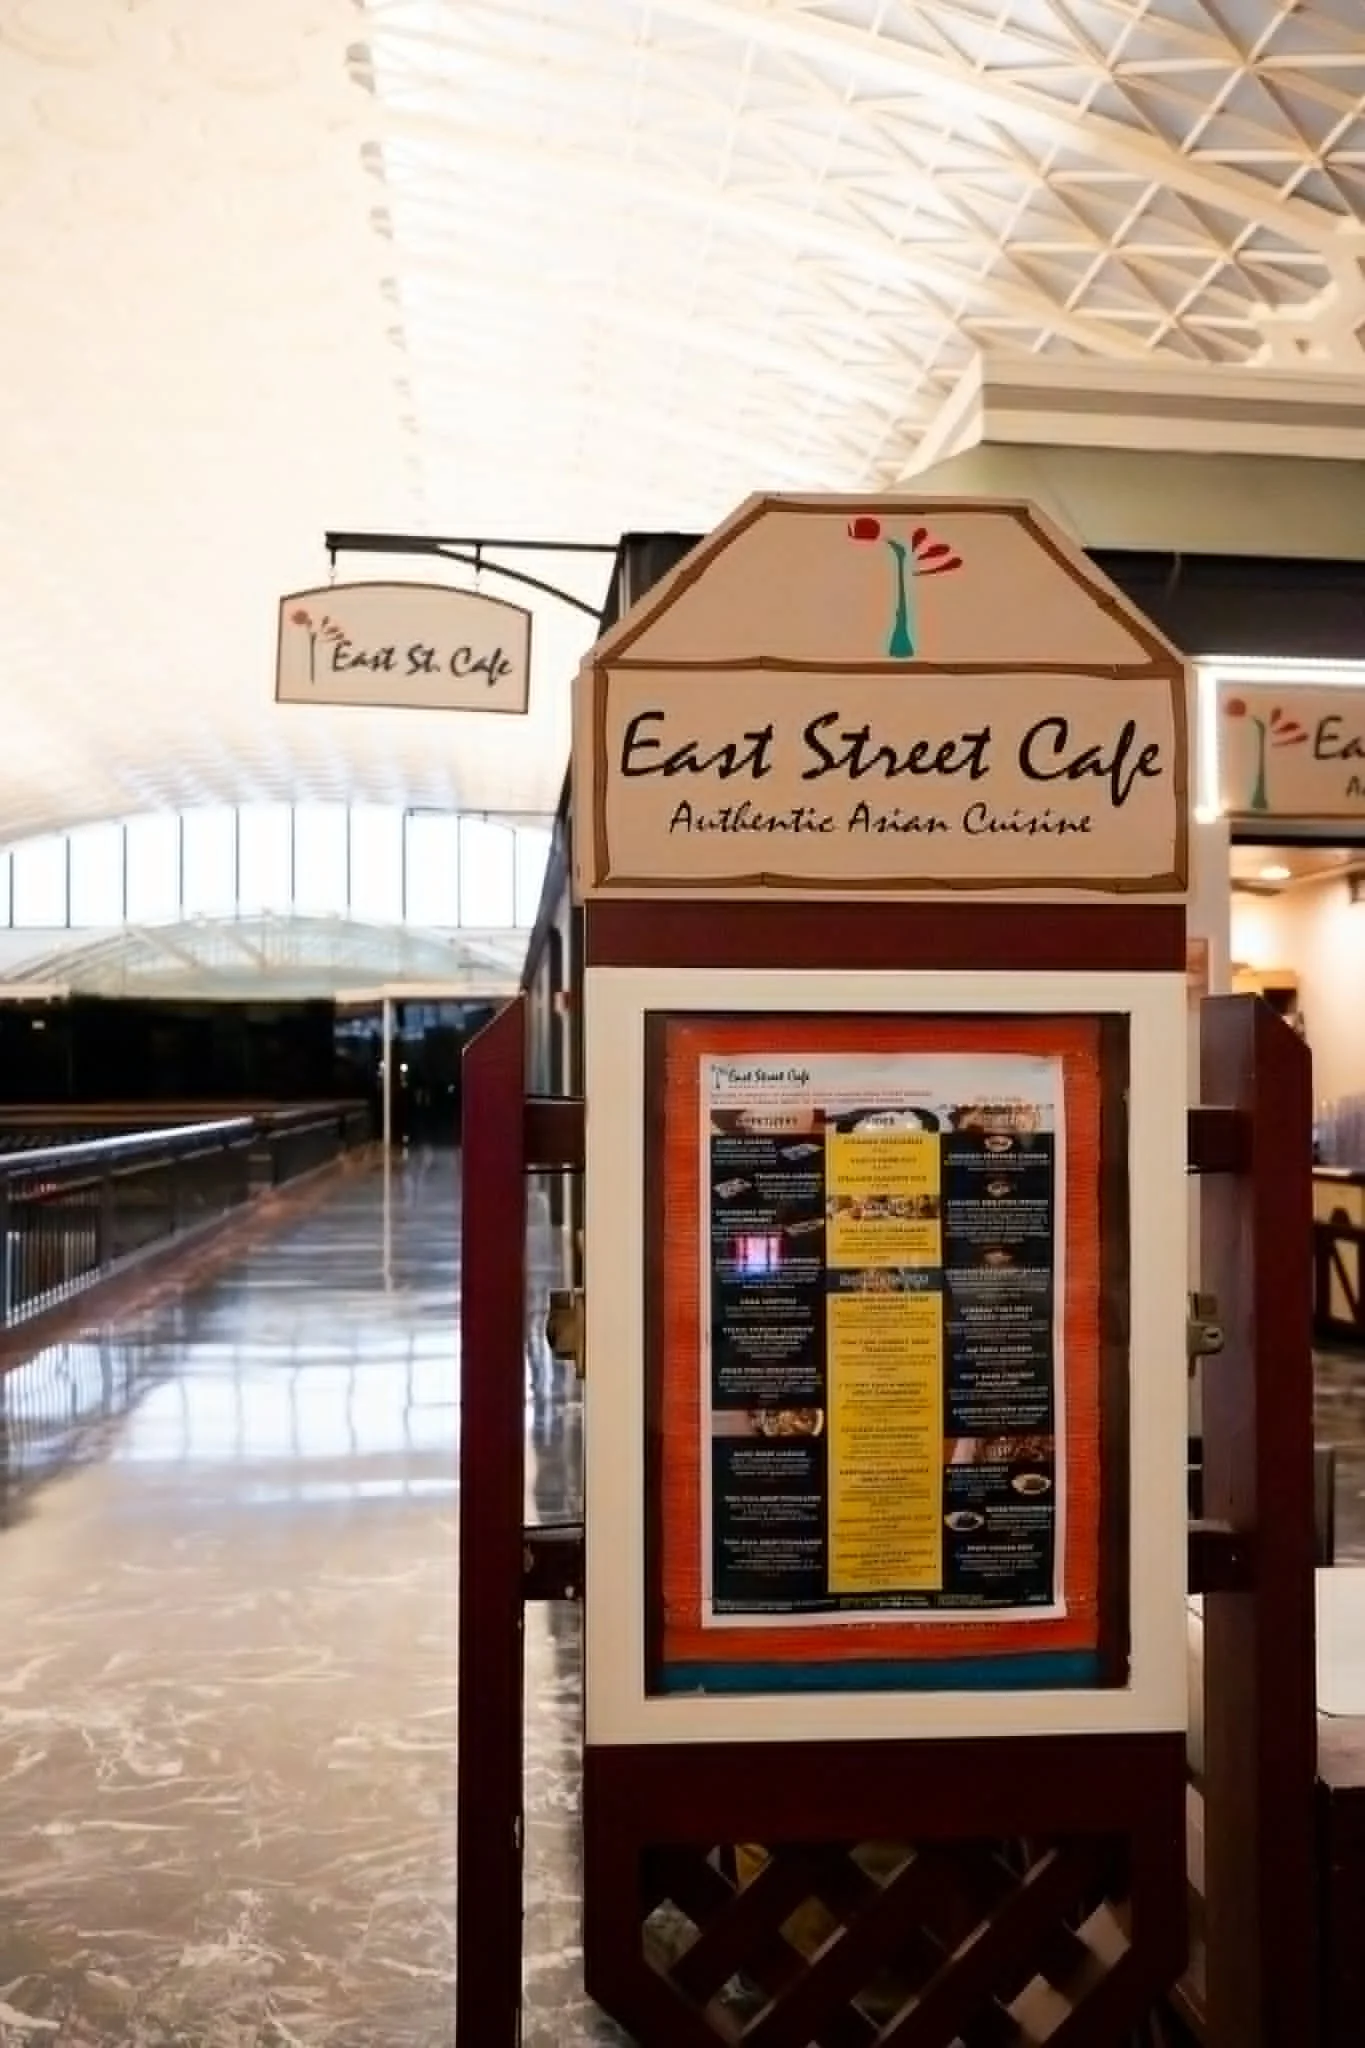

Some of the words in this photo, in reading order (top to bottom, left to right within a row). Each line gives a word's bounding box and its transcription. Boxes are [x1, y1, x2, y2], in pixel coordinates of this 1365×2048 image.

[331, 641, 398, 672] East
[406, 643, 441, 675] St.
[450, 645, 514, 687] Cafe
[620, 711, 775, 779] East
[801, 711, 993, 781] Street
[1018, 715, 1164, 807] Cafe
[668, 800, 837, 835] Authentic
[847, 802, 952, 835] Asian
[961, 802, 1092, 836] Cuisine
